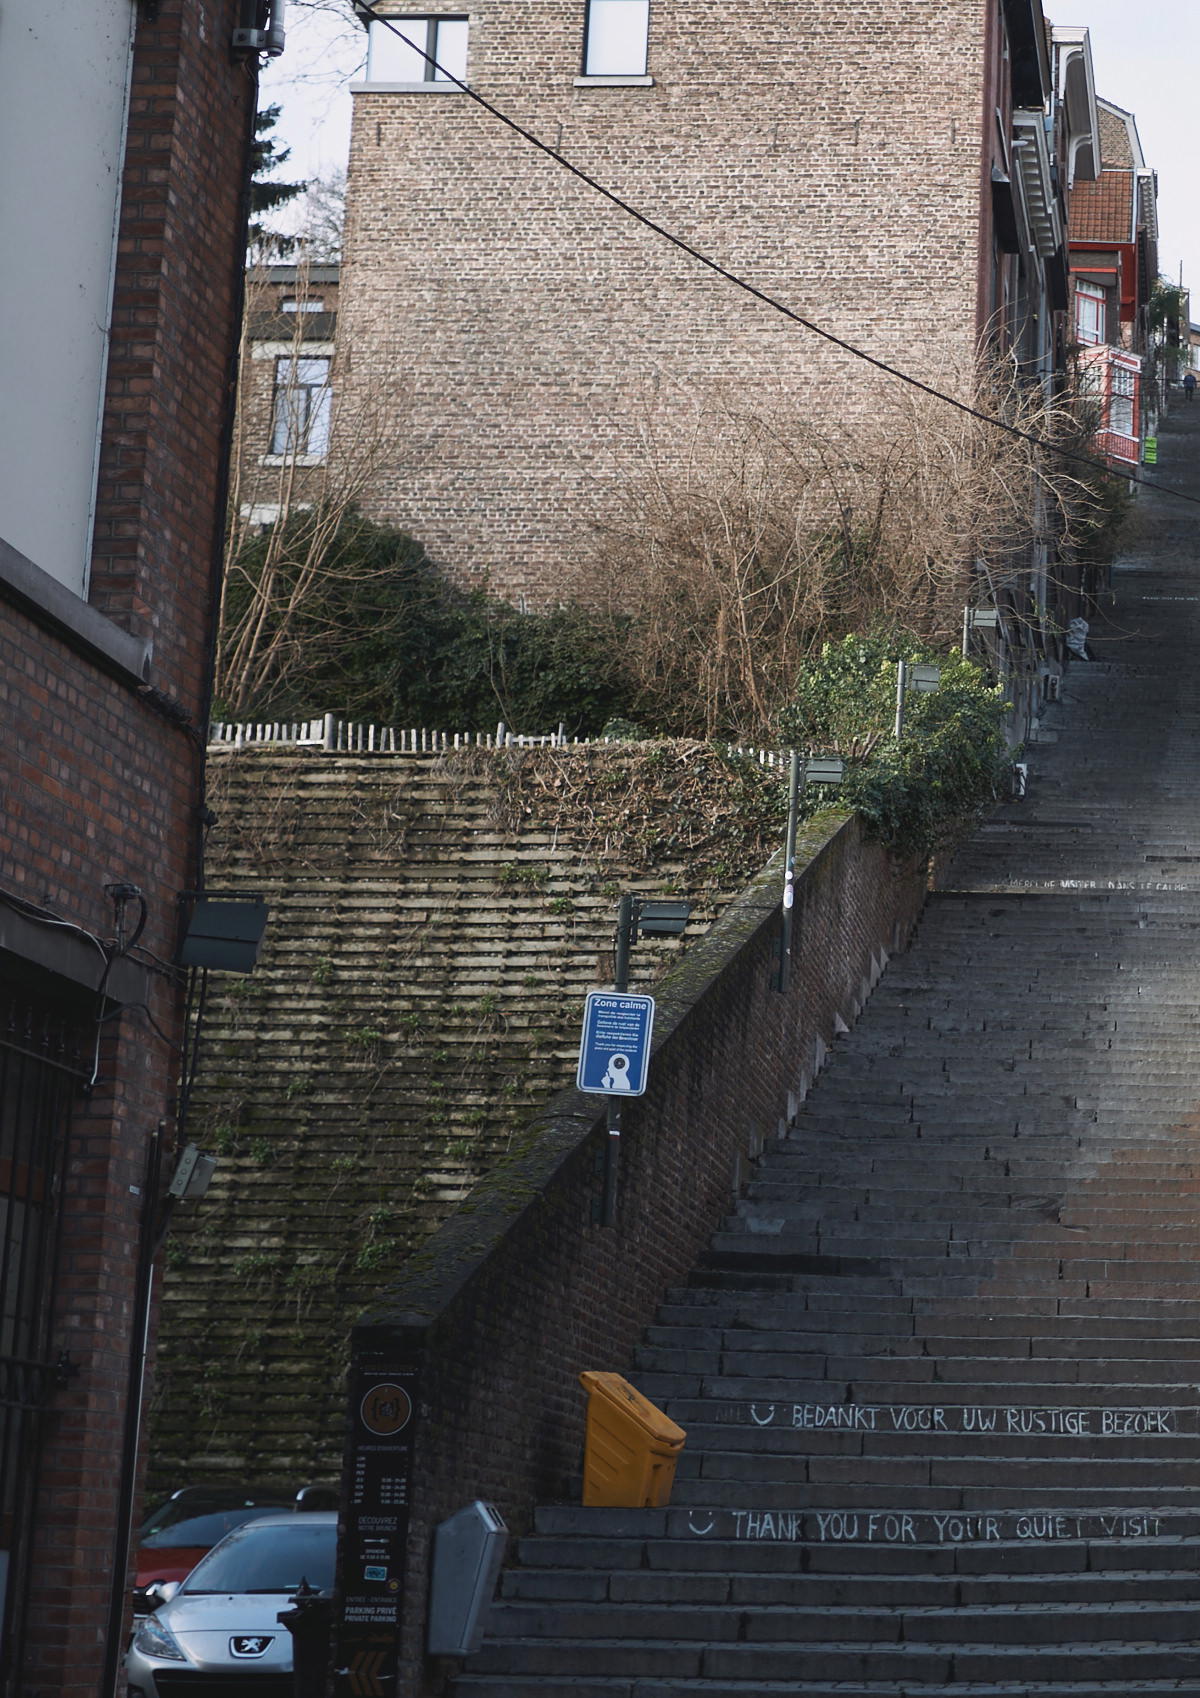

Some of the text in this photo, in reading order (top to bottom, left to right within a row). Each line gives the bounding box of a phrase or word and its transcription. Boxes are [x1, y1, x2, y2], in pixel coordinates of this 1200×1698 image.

[594, 998, 647, 1010] Zone calme
[792, 1404, 880, 1429] BEDANKT
[890, 1407, 948, 1430] VOOR
[963, 1408, 997, 1431] UW
[1006, 1409, 1091, 1434] RUSTIGE
[732, 1511, 801, 1540] THANK
[817, 1512, 858, 1541] YOU
[867, 1513, 916, 1543] FOR
[932, 1515, 1000, 1542] YOUR
[345, 1606, 375, 1615] PARKING
